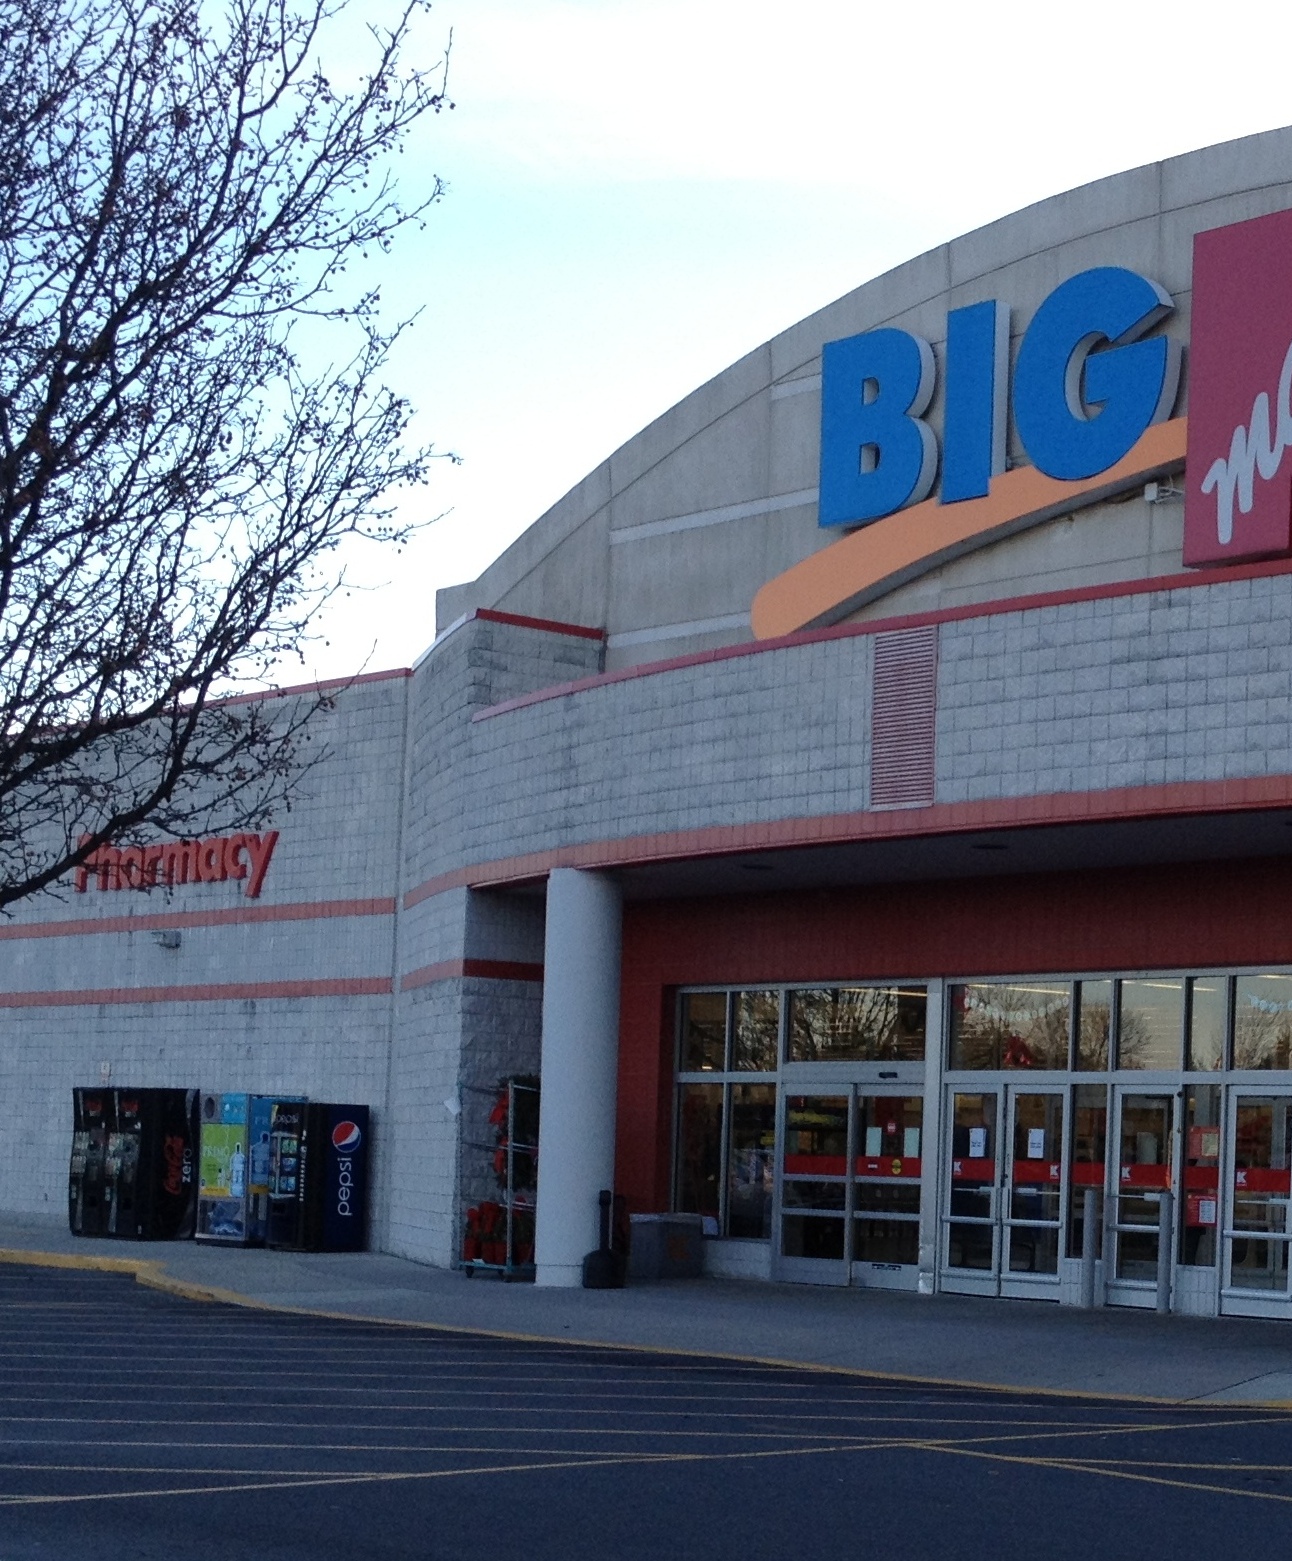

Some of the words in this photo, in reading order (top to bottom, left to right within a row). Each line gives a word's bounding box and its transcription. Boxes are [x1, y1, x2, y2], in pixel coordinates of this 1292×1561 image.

[817, 265, 1182, 529] BIG
[75, 830, 280, 898] Pharmacy
[182, 1148, 193, 1183] zero
[337, 1157, 354, 1217] pepsi
[1236, 1171, 1247, 1183] K
